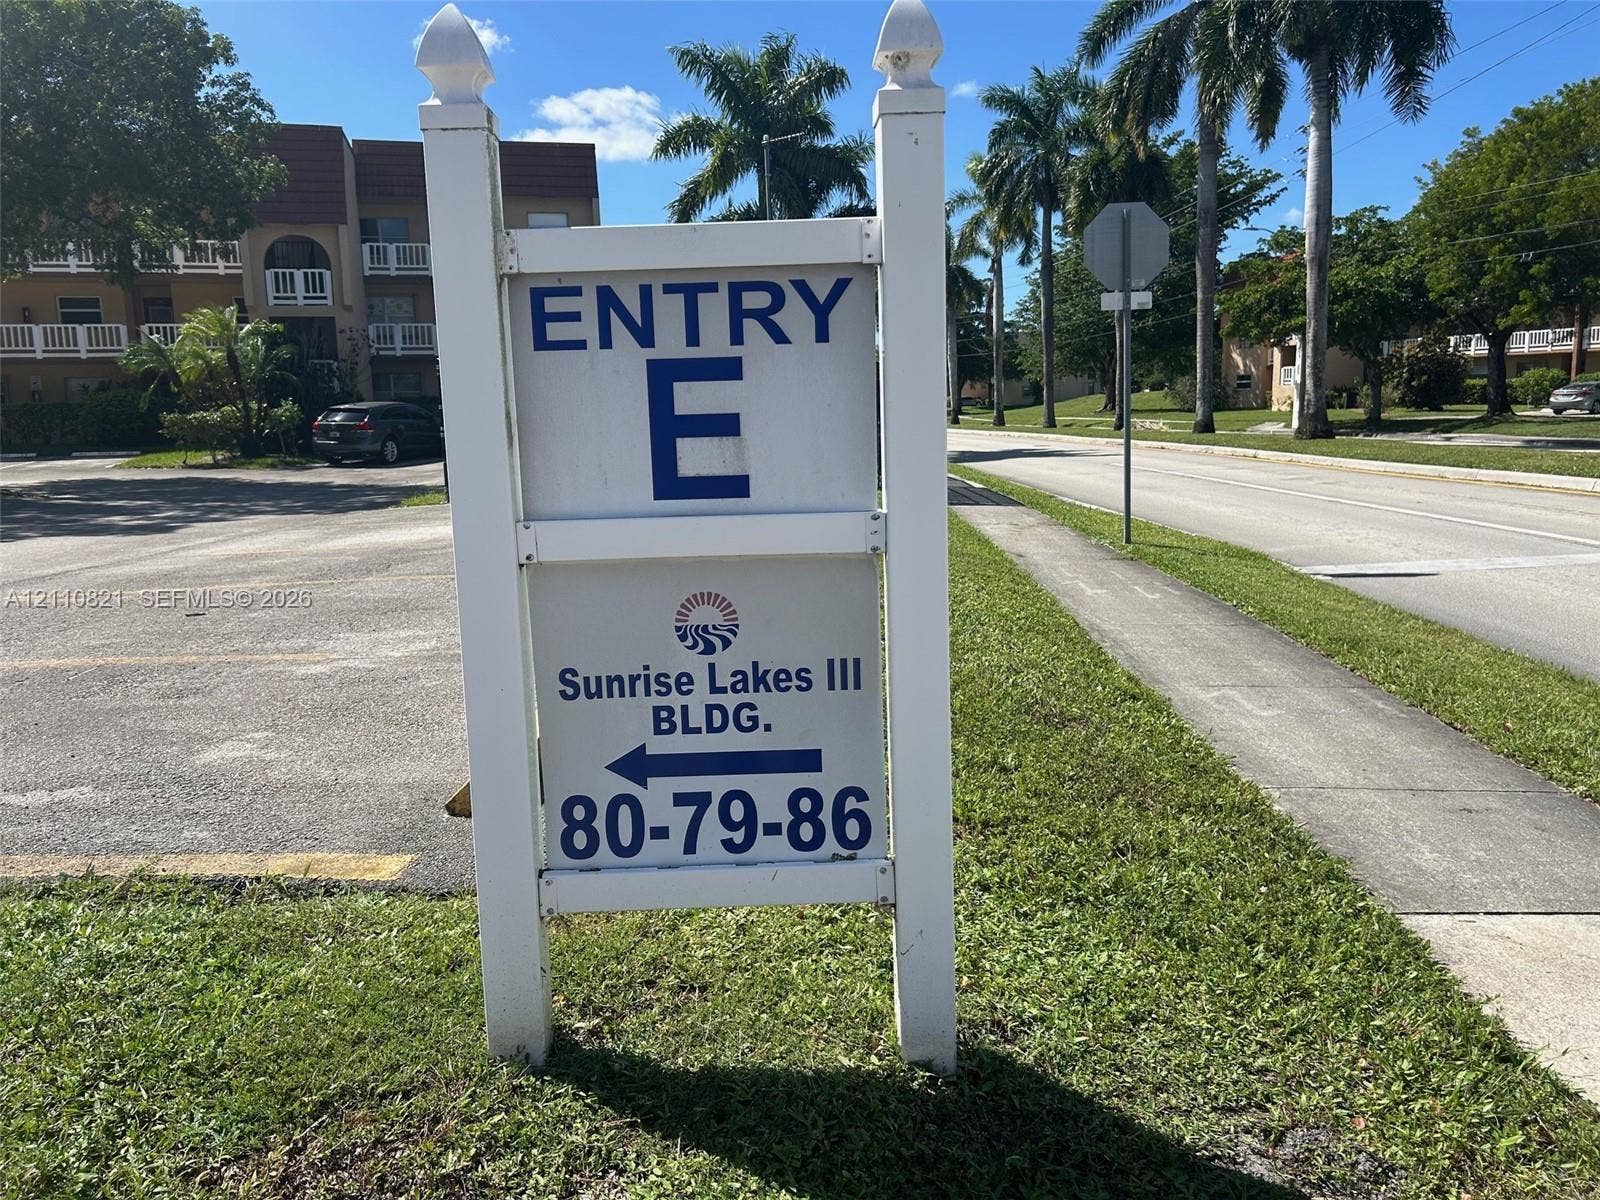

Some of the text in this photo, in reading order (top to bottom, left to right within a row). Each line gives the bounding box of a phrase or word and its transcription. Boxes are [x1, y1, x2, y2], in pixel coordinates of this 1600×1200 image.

[529, 277, 853, 352] ENTRY
[646, 356, 751, 501] E
[558, 657, 862, 701] Sunrise Lakes III
[652, 702, 773, 736] BLDG.
[560, 786, 873, 861] 80-79-86
